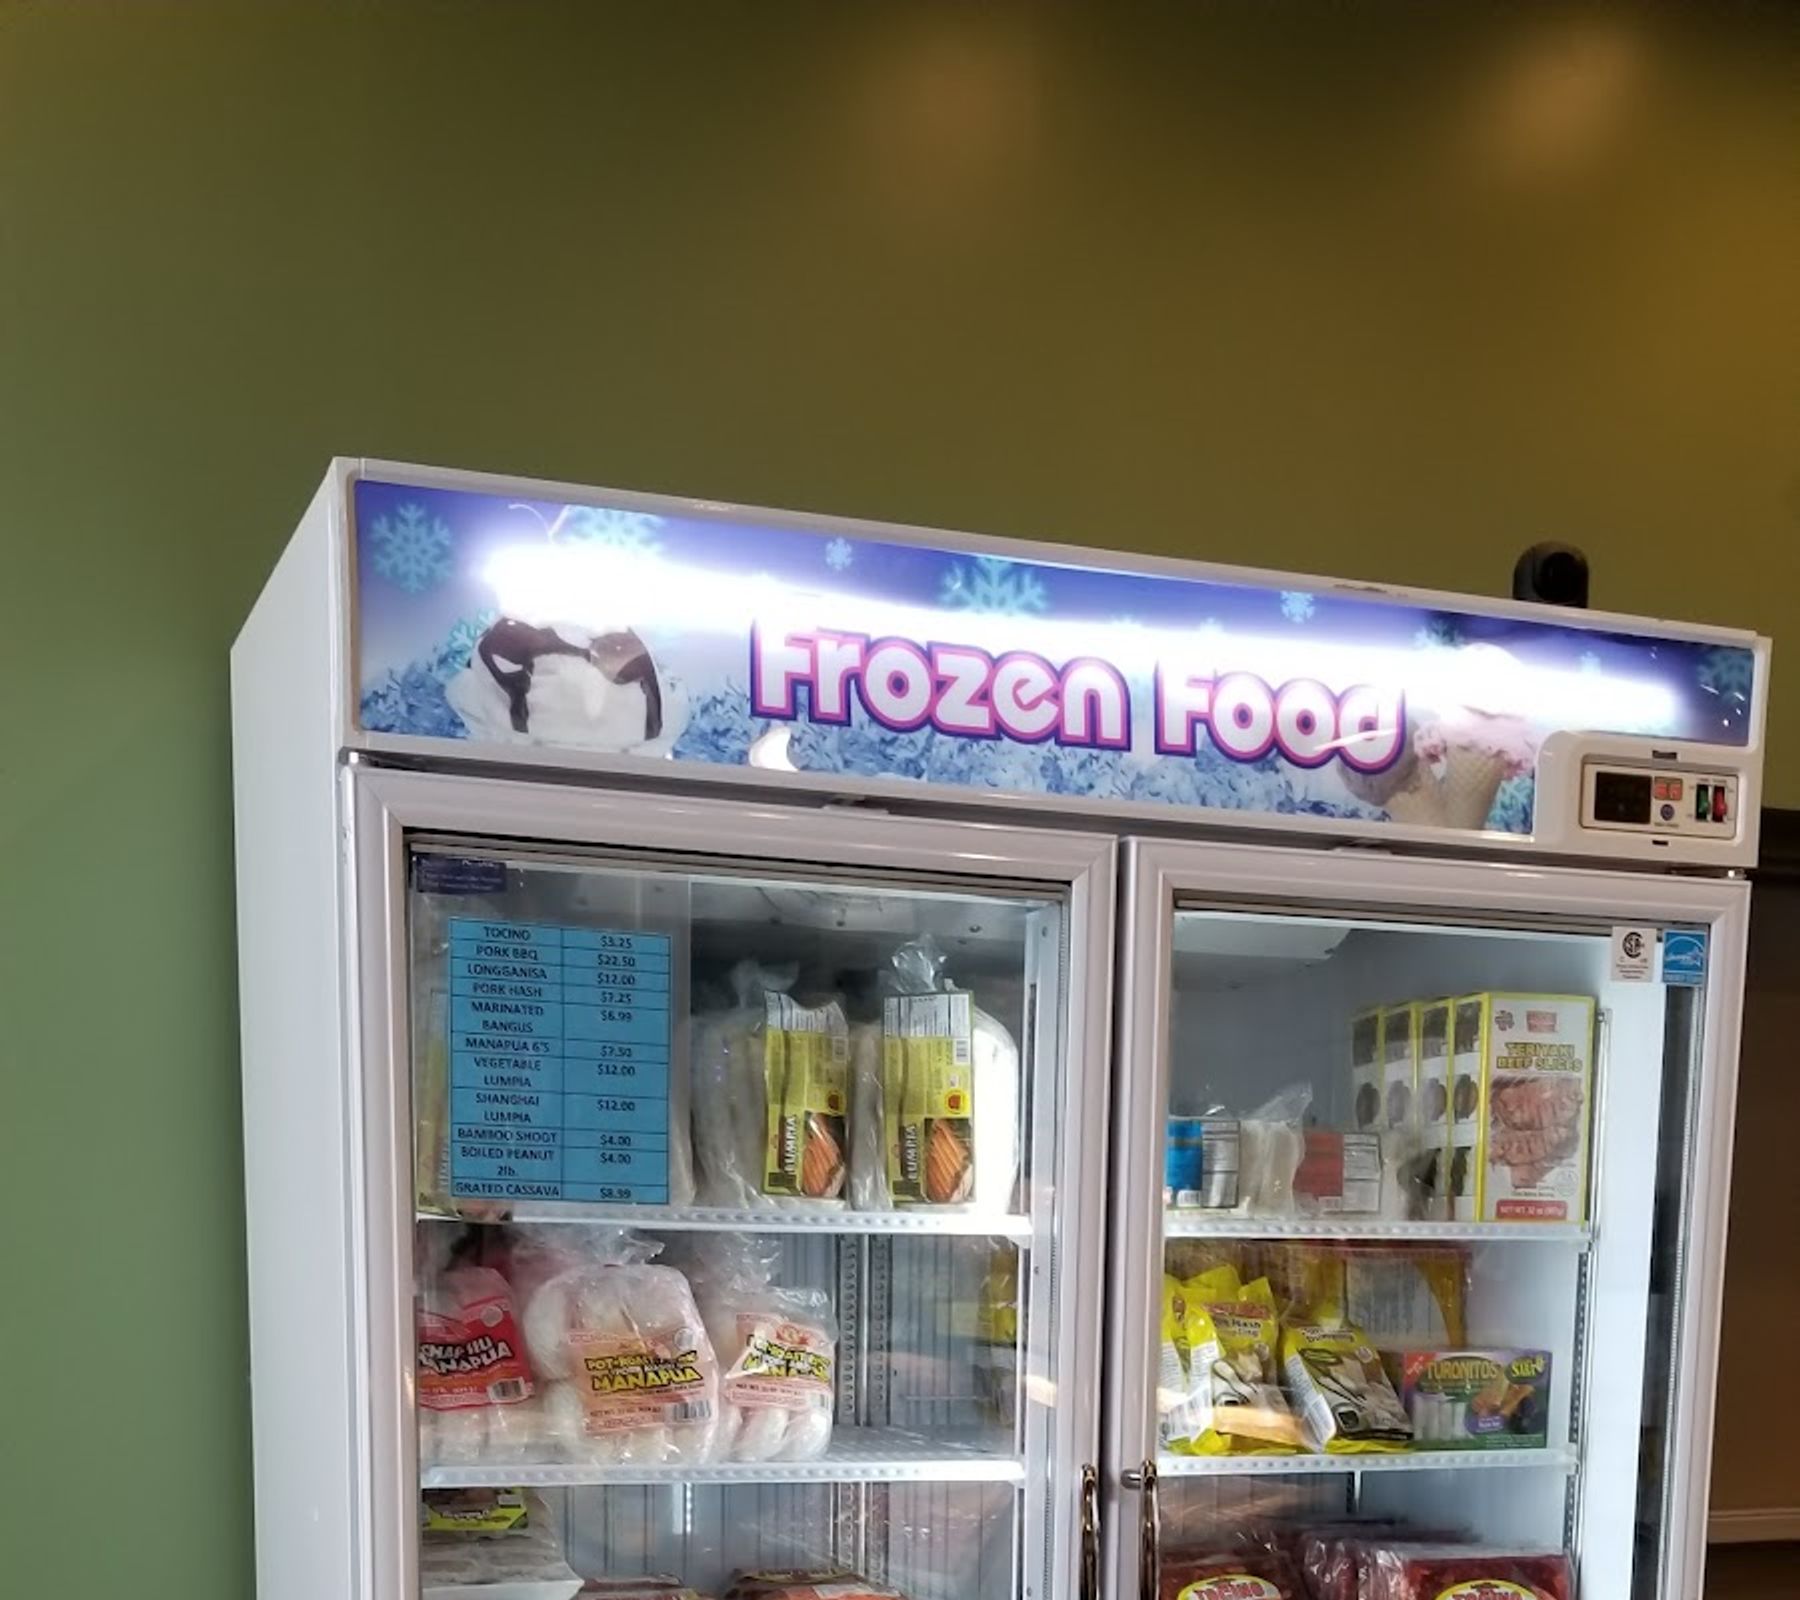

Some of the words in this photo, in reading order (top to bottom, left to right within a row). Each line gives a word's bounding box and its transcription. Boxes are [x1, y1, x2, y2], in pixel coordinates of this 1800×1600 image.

[749, 616, 1131, 752] Frozen
[1154, 657, 1406, 775] Food
[483, 926, 531, 941] TOCINO
[600, 936, 632, 949] $3.25
[476, 945, 510, 958] PORK
[511, 948, 539, 961] BBQ
[597, 954, 637, 968] $22.50
[467, 963, 548, 979] LONGGANISA
[597, 972, 637, 985] $12.00
[472, 982, 507, 995] PORK
[508, 984, 543, 998] HASH
[471, 1001, 544, 1016] MARINATED
[481, 1019, 534, 1033] BANGUS
[465, 1037, 528, 1051] MANAPUA
[473, 1057, 542, 1072] VEGETABLE
[597, 1063, 637, 1077] $12.00
[483, 1074, 532, 1088] LUMPIA
[475, 1092, 540, 1106] SHANGHAI
[597, 1098, 637, 1112] $12.00
[483, 1110, 532, 1123] LUMPIA
[457, 1127, 513, 1141] BAMBOO
[515, 1130, 558, 1143] SHOOT
[600, 1134, 632, 1147] $4.00
[461, 1146, 505, 1160] BOILED
[507, 1149, 554, 1162] PEANUT
[600, 1151, 632, 1164] $4.00
[456, 1181, 504, 1194] GRATED
[506, 1184, 560, 1197] CASSAVA
[592, 1365, 703, 1392] MANAPUA
